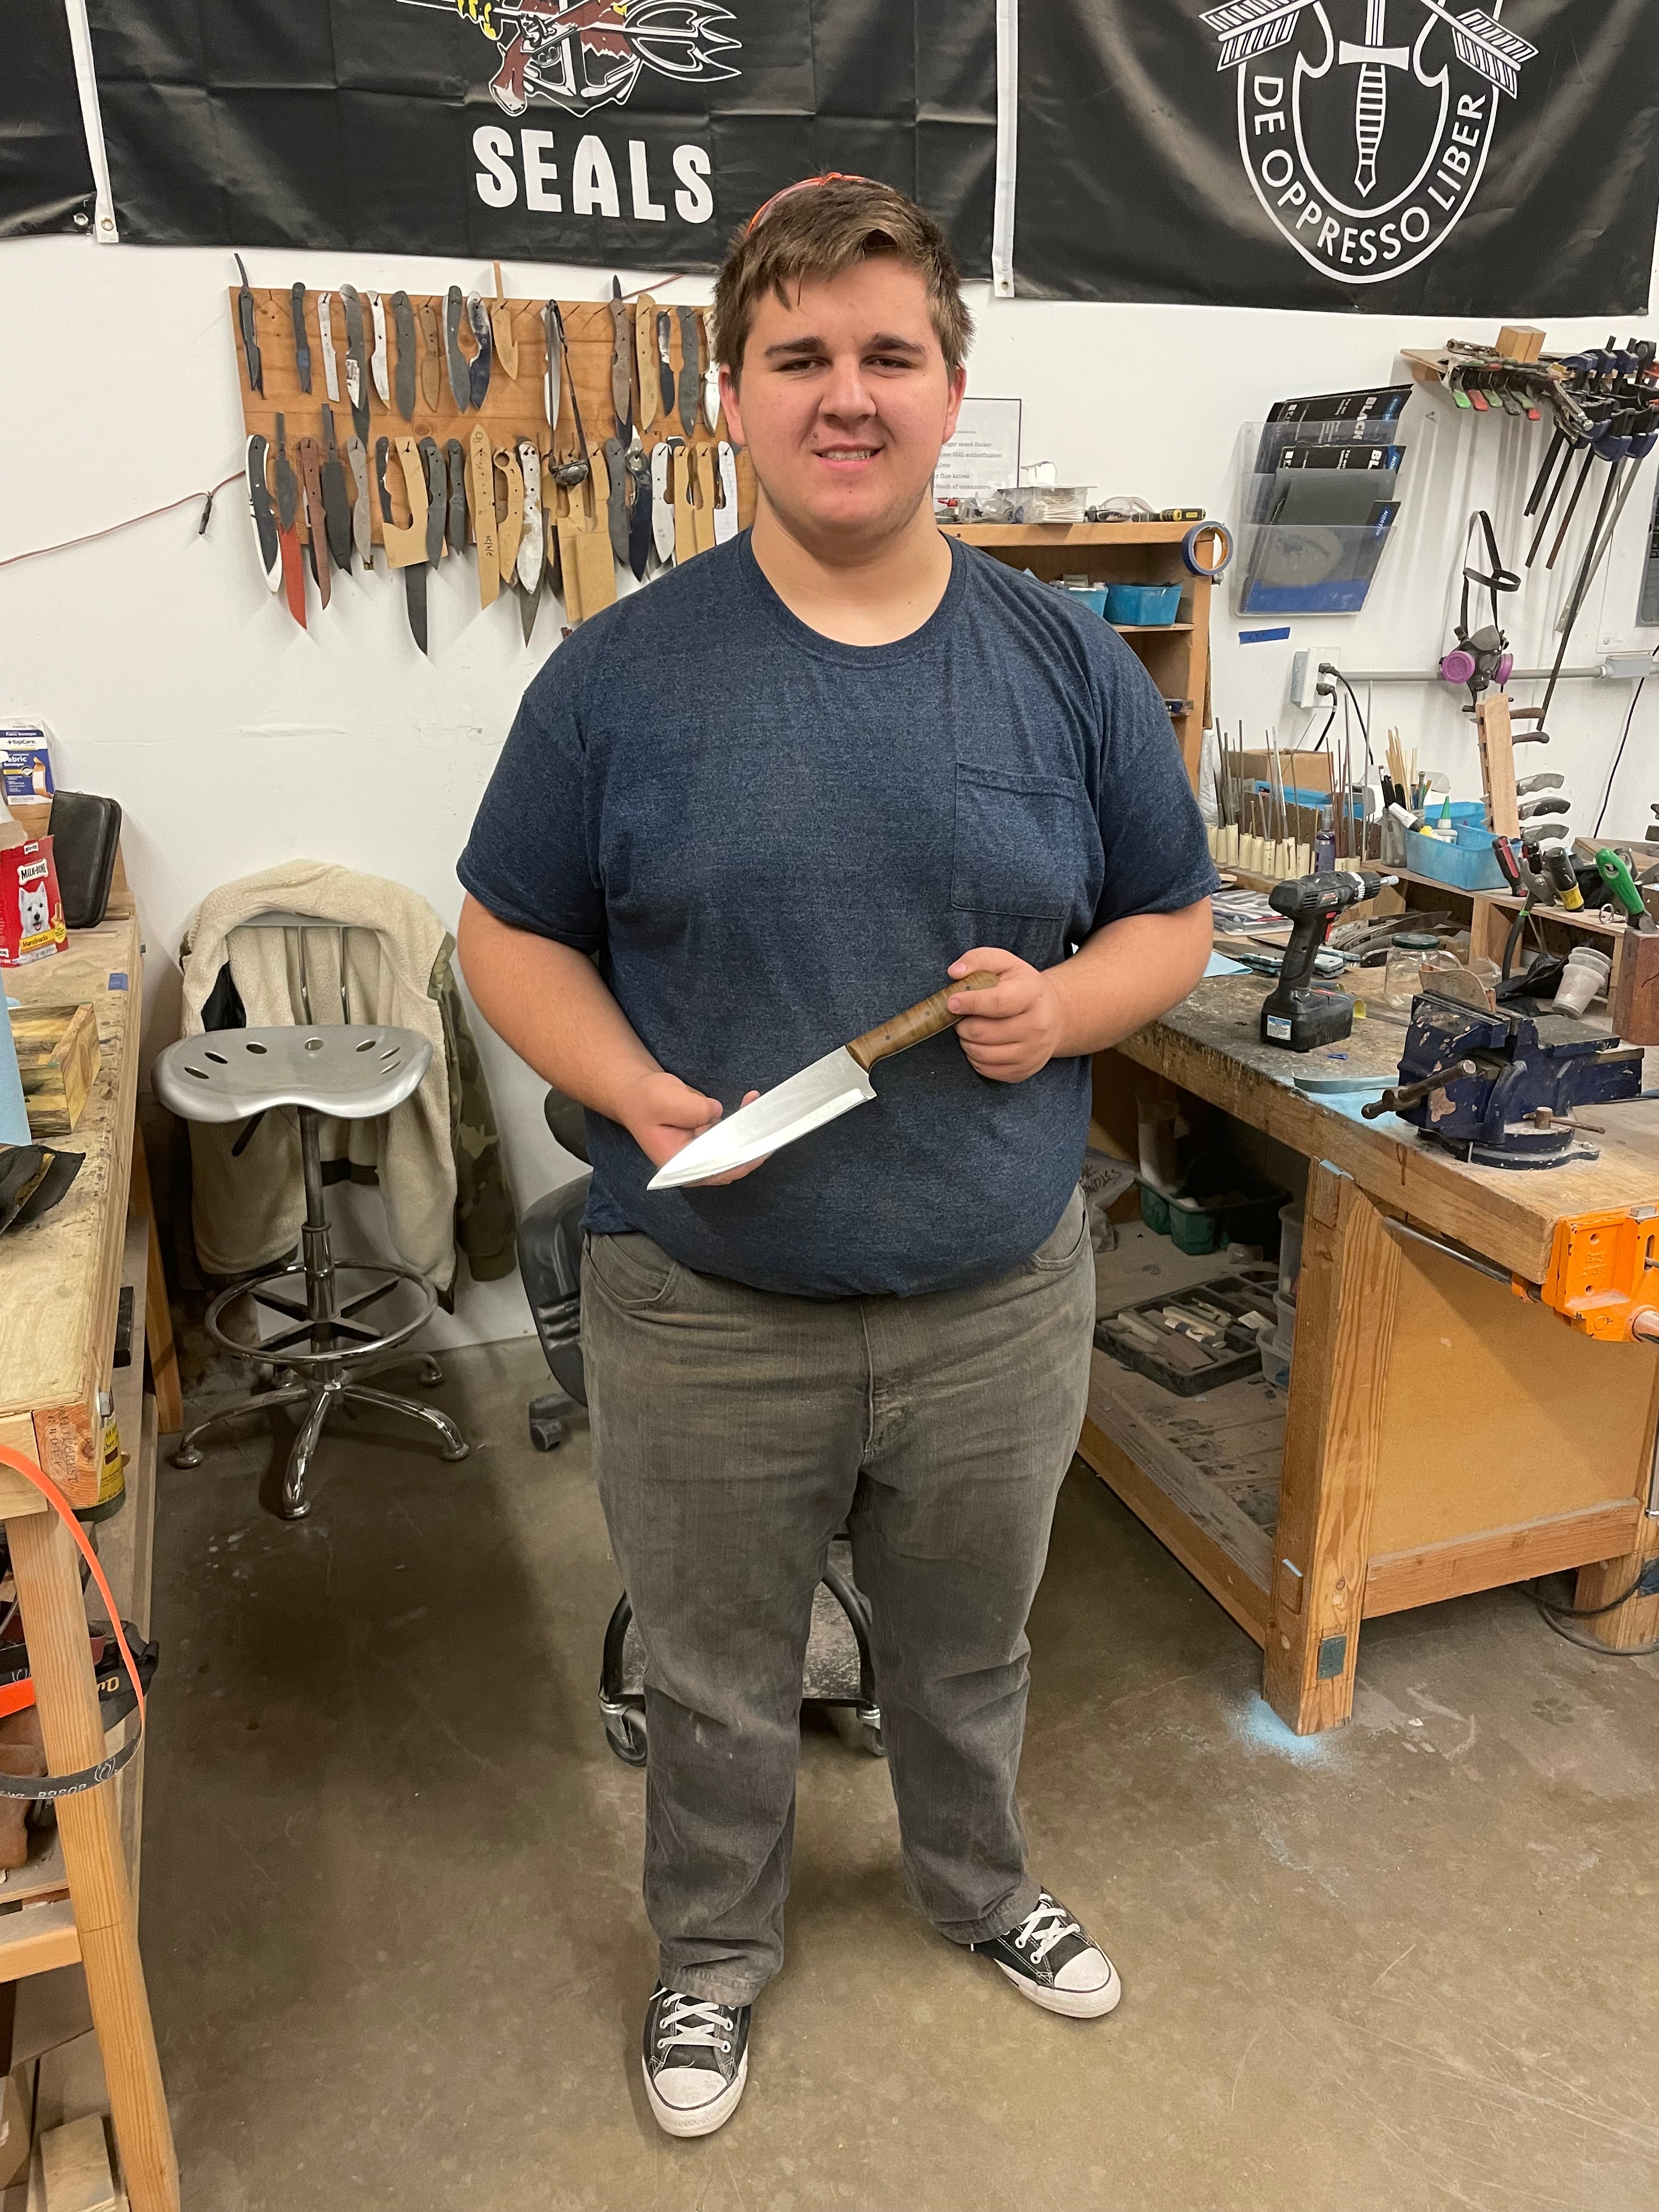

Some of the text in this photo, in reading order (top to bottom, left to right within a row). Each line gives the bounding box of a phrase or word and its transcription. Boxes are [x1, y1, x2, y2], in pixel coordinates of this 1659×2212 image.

[472, 126, 713, 223] SEALS
[1254, 76, 1486, 266] DE OPPRESSO LIBER
[1353, 397, 1378, 439] BLACK
[1376, 510, 1388, 536] NORTON
[21, 862, 47, 881] MILK-BONE
